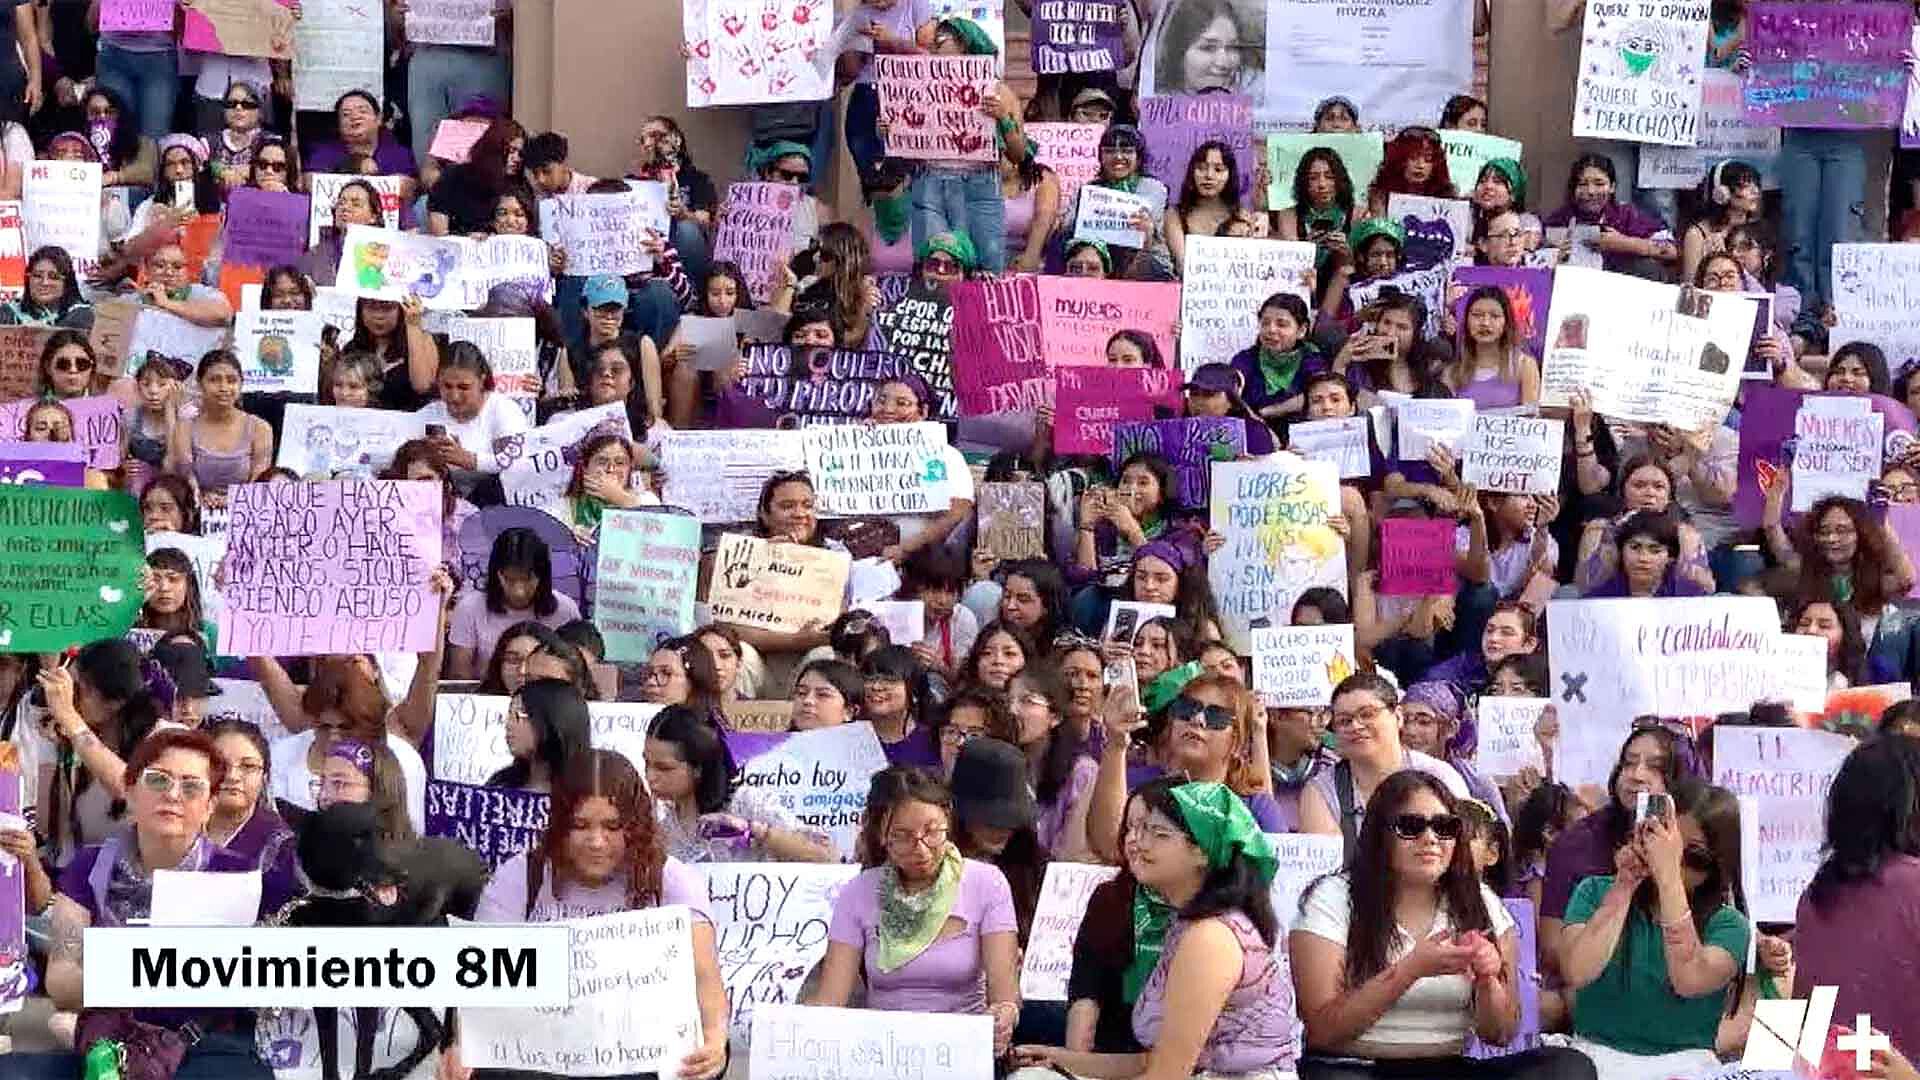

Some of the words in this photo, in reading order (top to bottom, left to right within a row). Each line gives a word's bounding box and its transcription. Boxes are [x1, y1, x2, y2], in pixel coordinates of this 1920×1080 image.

[1639, 4, 1656, 17] TU
[1650, 89, 1678, 109] SUS
[1227, 261, 1276, 281] AMIGA
[879, 312, 895, 326] TE
[896, 298, 938, 319] ¿POR
[892, 330, 921, 346] POR
[748, 346, 793, 376] NO
[789, 380, 878, 412] PIROP
[1237, 471, 1308, 500] LIBRES
[1489, 472, 1533, 490] UAT
[234, 480, 326, 511] AUNQUE
[340, 480, 405, 509] HAYA
[231, 507, 318, 537] PASADO
[332, 506, 397, 536] AYER
[228, 534, 314, 560] ANTIER
[323, 534, 339, 560] O
[348, 532, 421, 560] HACE
[227, 558, 254, 586] 10
[342, 557, 422, 587] SIGUE
[1243, 565, 1275, 588] SIN
[29, 602, 111, 630] ELLAS
[226, 585, 324, 619] SIENDO
[335, 587, 422, 619] ABUSO
[285, 614, 314, 653] TE
[329, 614, 410, 653] CREO!
[449, 695, 477, 726] YO
[812, 759, 848, 793] hoy
[802, 791, 866, 813] amigas
[707, 873, 800, 923] HOY
